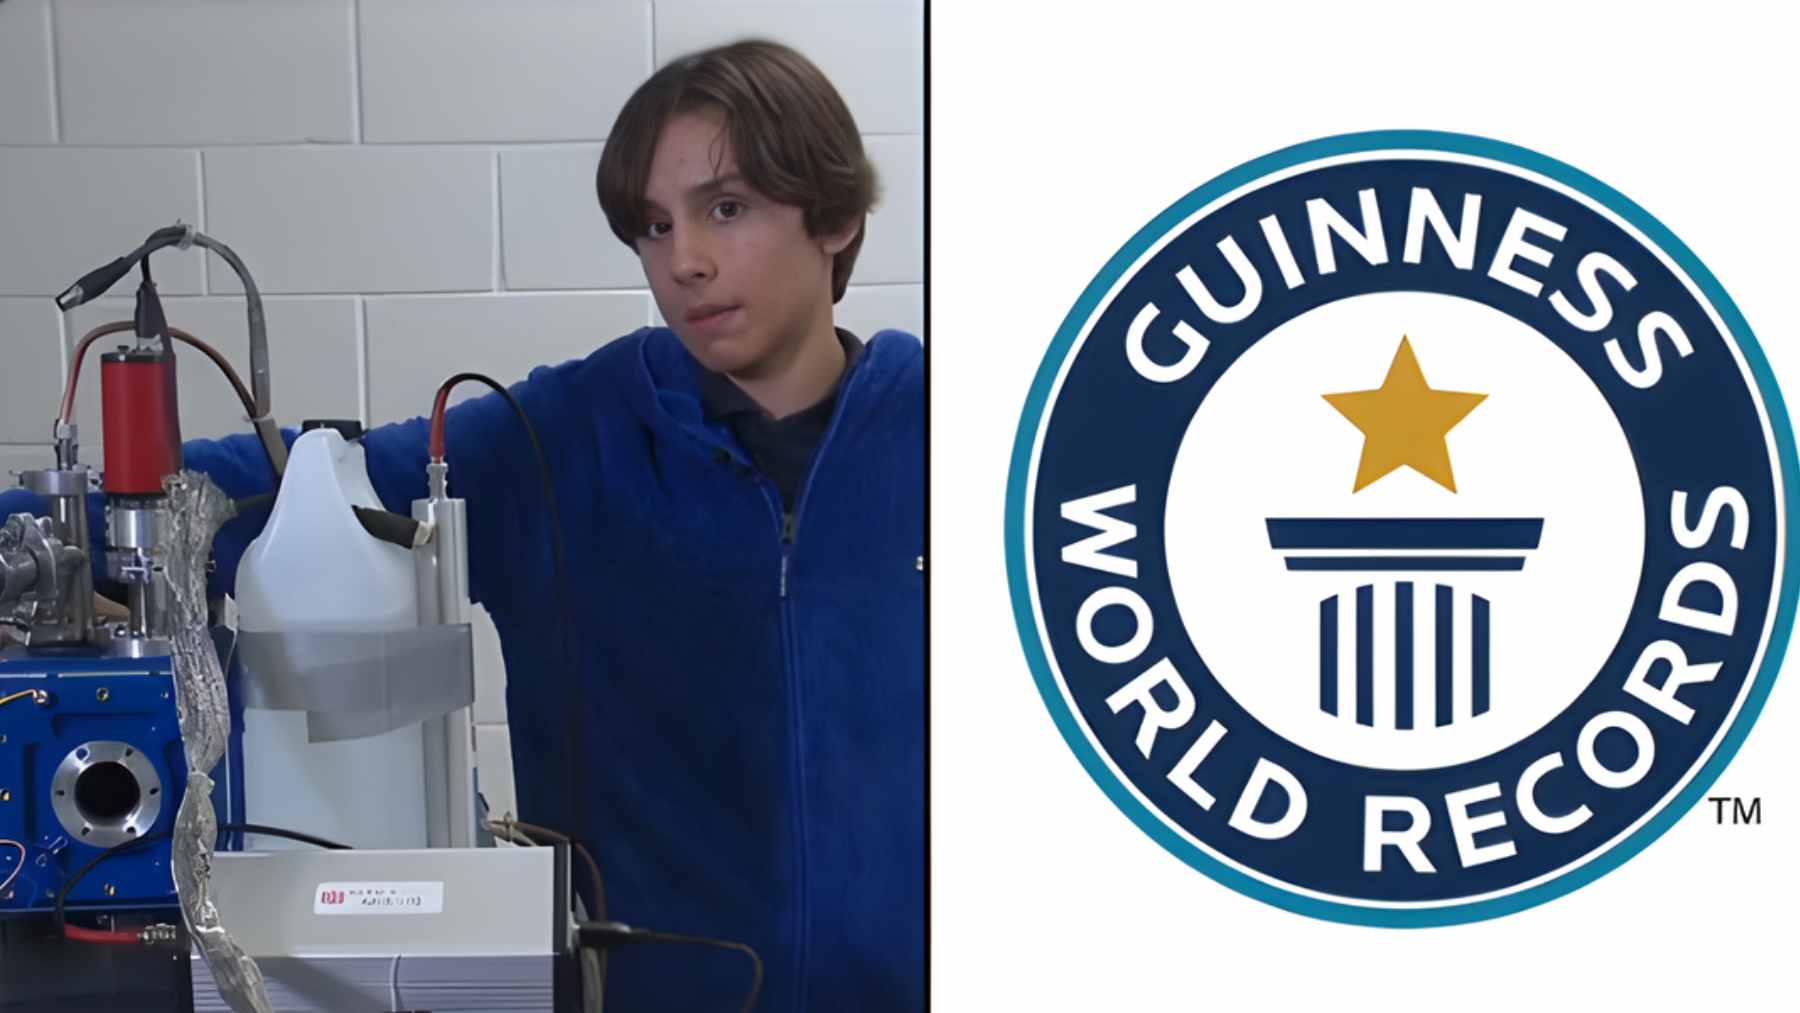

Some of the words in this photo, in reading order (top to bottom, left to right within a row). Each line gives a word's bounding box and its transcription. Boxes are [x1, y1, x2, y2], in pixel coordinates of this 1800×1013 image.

[1125, 186, 1694, 389] GUINNESS
[1060, 483, 1308, 840] WORLD
[1363, 485, 1750, 873] RECORDS
[1708, 797, 1761, 825] TM
